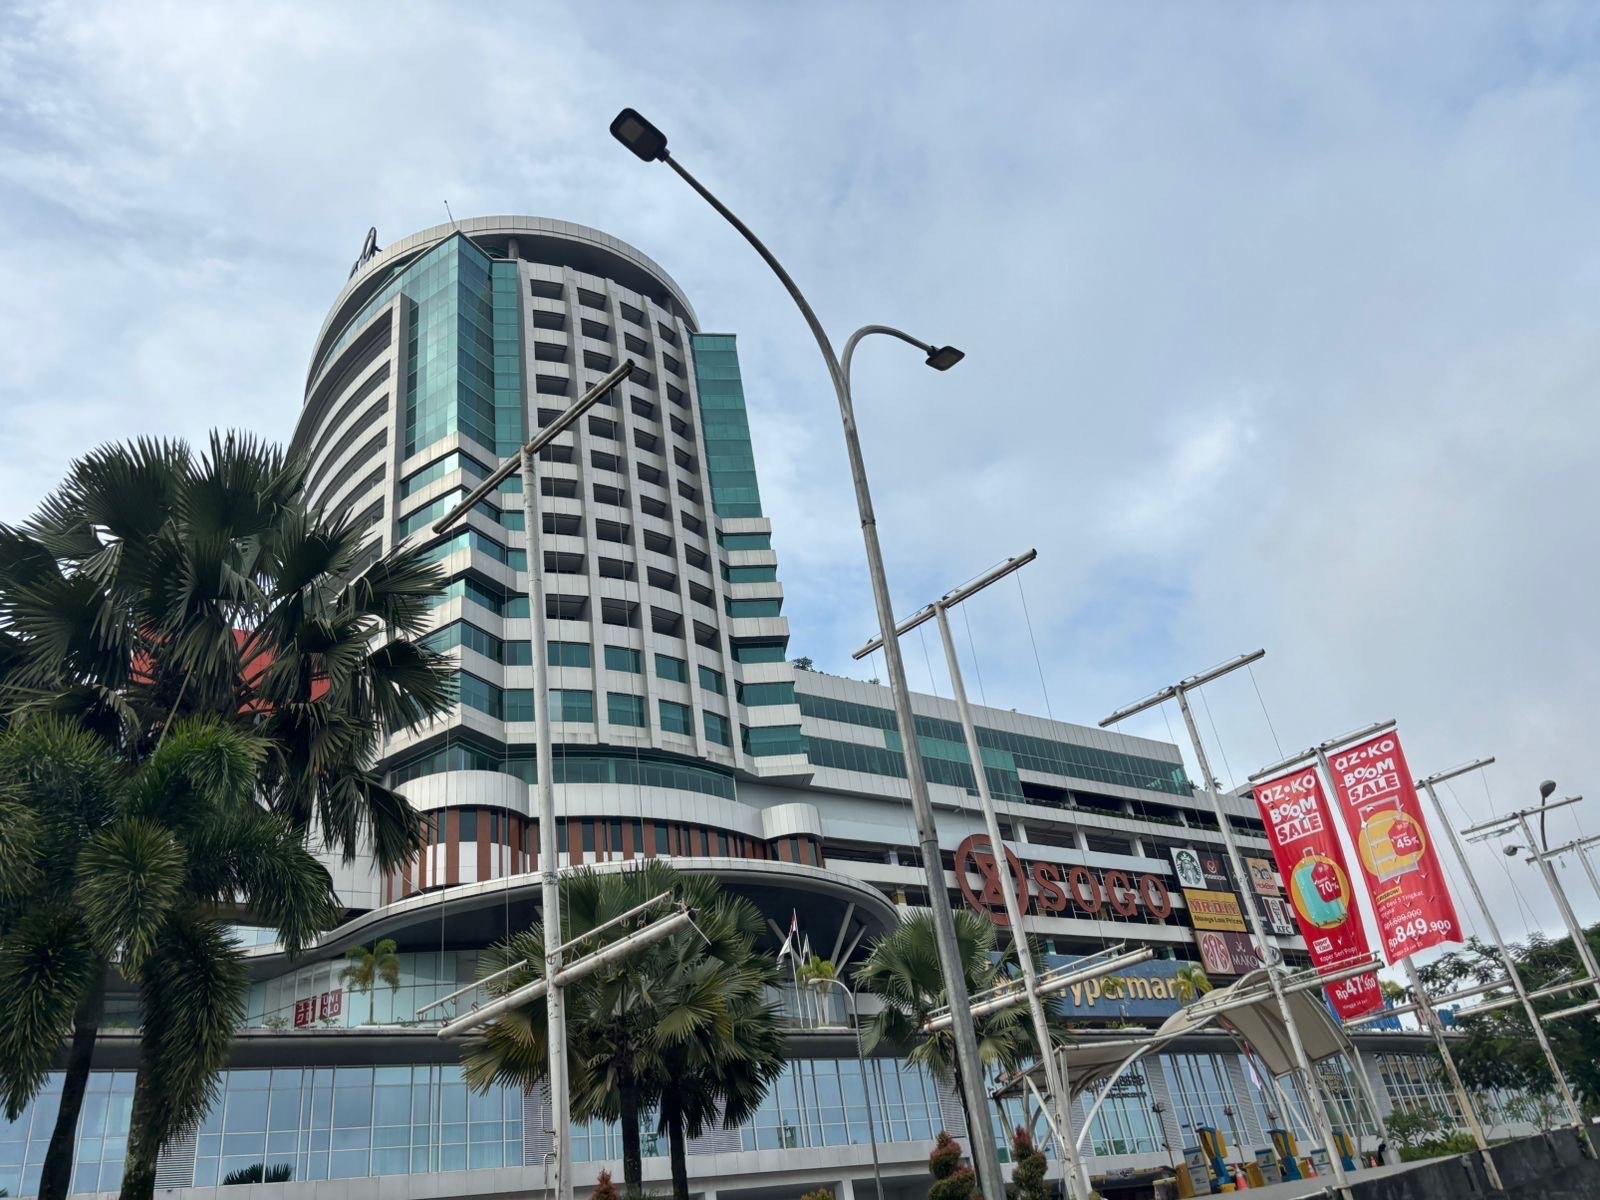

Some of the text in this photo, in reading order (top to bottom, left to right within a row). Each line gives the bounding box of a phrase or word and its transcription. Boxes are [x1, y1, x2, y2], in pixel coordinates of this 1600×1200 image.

[1350, 774, 1399, 805] SALE
[1275, 814, 1323, 843] SALE
[1396, 835, 1419, 848] 45%
[1033, 862, 1171, 919] SOGO
[1318, 881, 1339, 896] 70%
[1276, 925, 1292, 934] KFC
[1231, 954, 1258, 969] MAKO
[1044, 968, 1188, 1007] ypermar
[322, 993, 340, 1005] UNI
[322, 1003, 339, 1016] QLO
